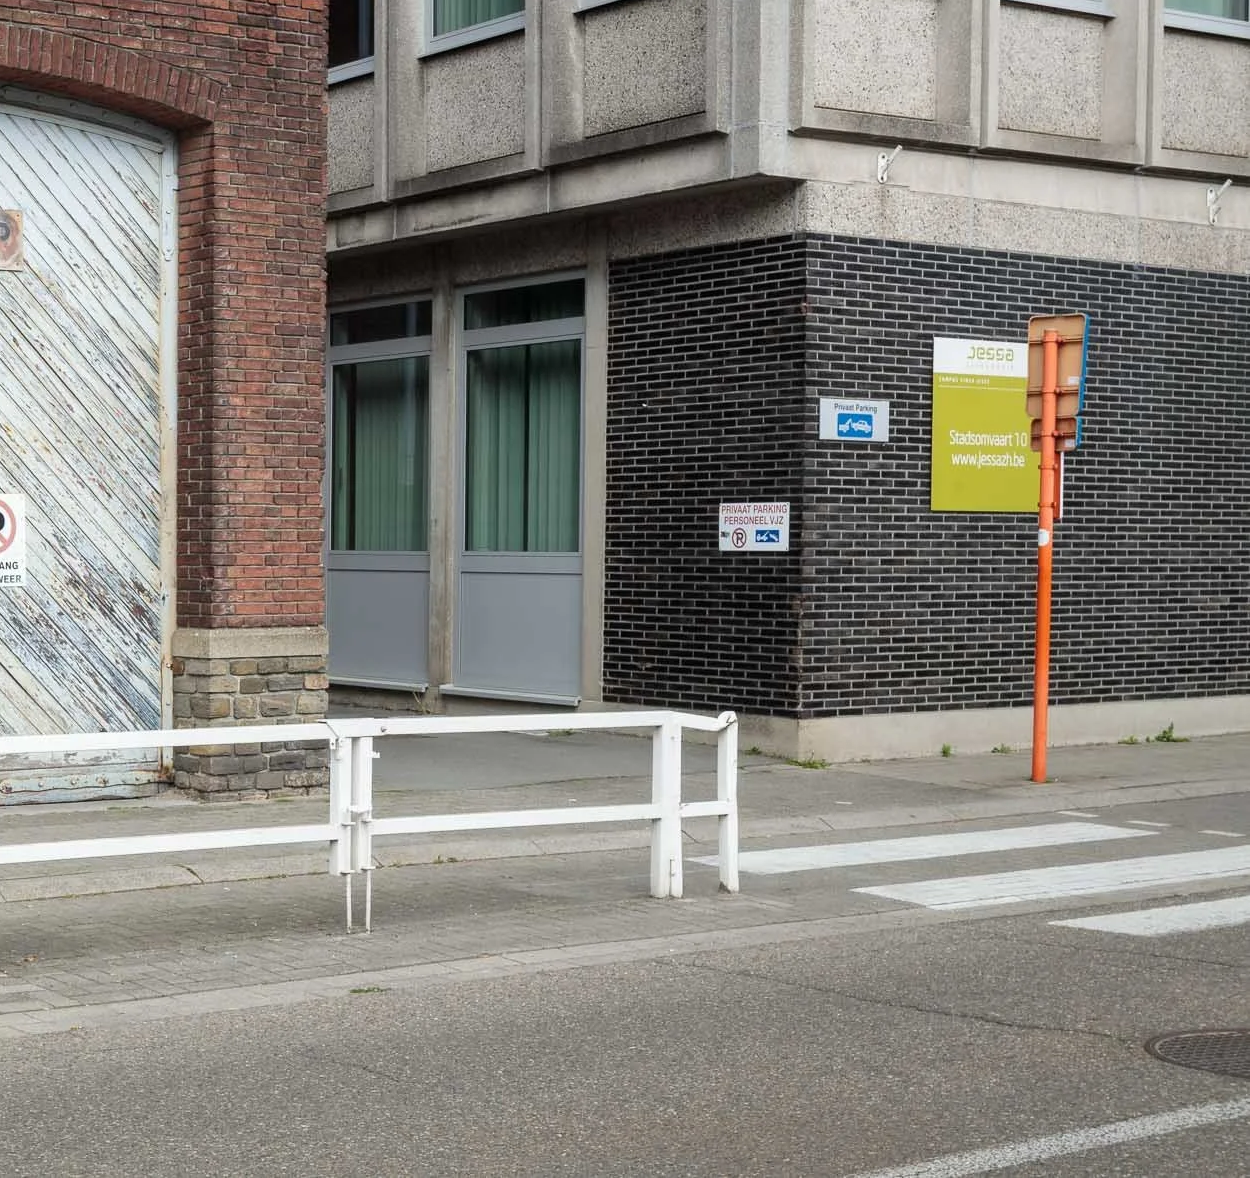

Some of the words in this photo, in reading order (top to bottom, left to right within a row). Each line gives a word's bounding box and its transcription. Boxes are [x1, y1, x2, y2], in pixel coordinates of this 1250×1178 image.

[834, 403, 854, 411] Privaat
[855, 404, 878, 414] Parking
[949, 429, 1013, 447] Stadsomvaart
[1014, 432, 1028, 447] 10
[951, 450, 1025, 469] www.jessazh.be
[721, 505, 752, 514] PRIVAAT
[753, 504, 788, 514] PARKING
[724, 516, 768, 525] PERSONEEL
[769, 515, 784, 525] VJZ
